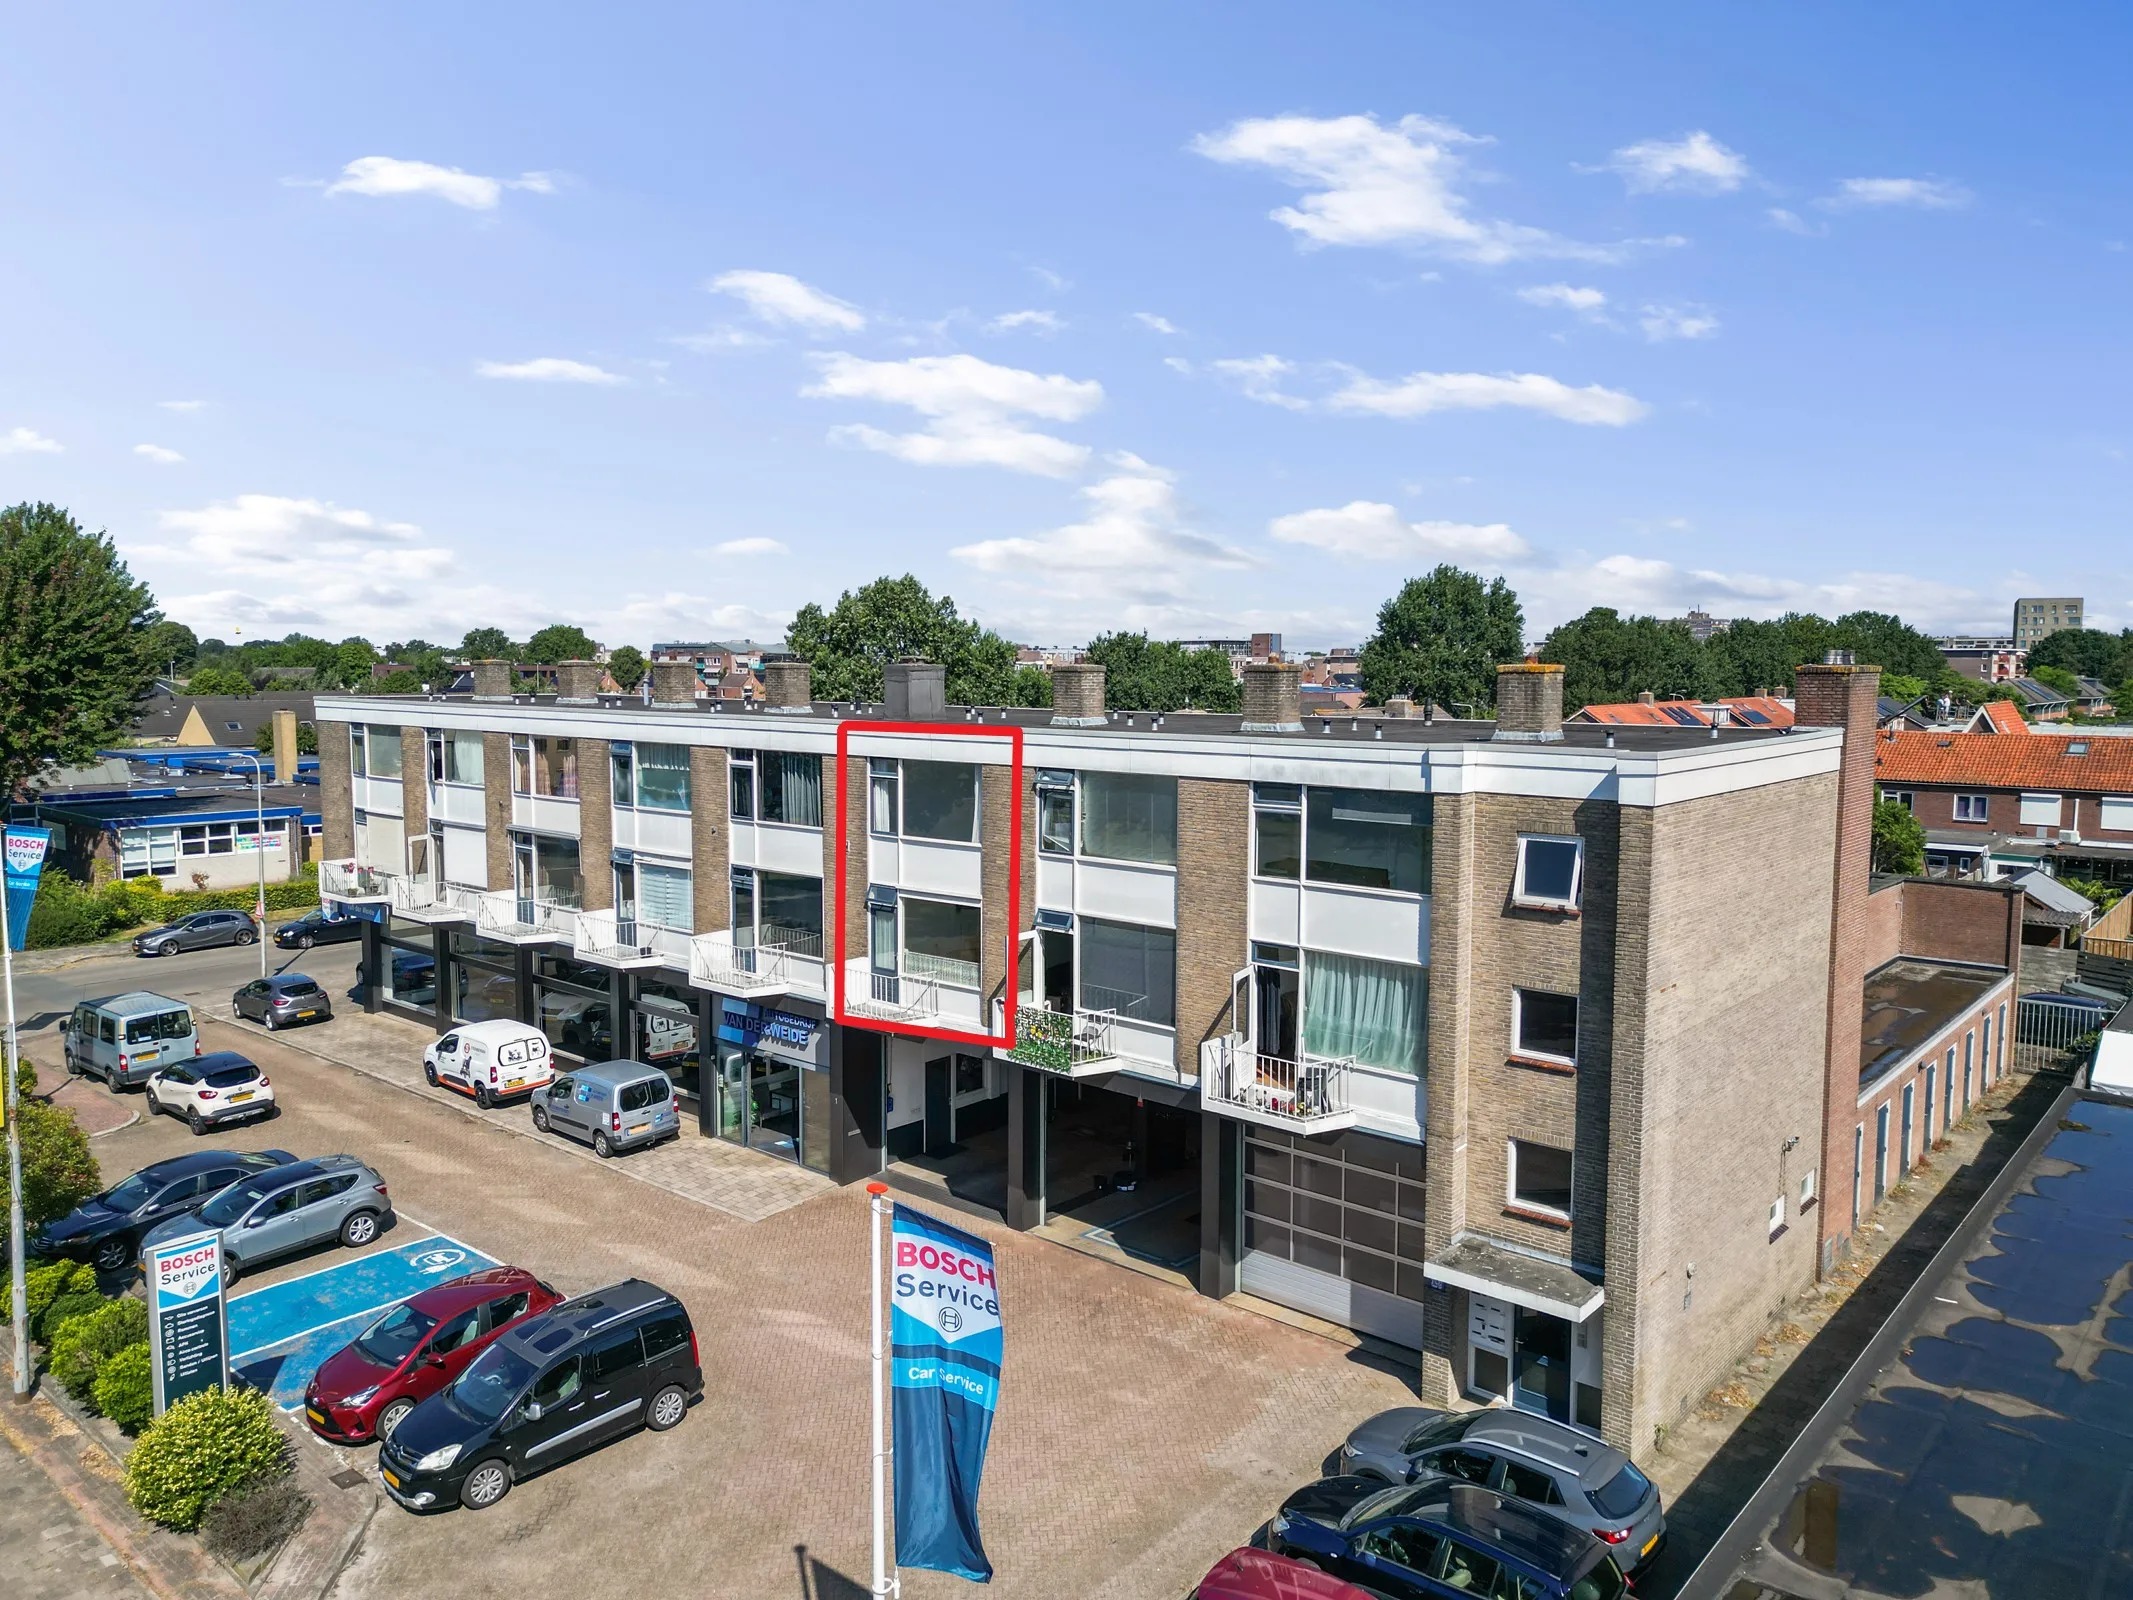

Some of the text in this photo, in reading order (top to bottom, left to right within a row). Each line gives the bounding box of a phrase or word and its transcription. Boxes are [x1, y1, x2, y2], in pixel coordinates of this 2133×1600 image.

[8, 838, 45, 850] BOSCH
[8, 848, 42, 860] Service
[724, 1012, 744, 1029] VAN
[770, 1022, 809, 1045] WEIDE
[160, 1247, 215, 1273] BOSCH
[897, 1241, 996, 1291] BOSCH
[161, 1263, 216, 1285] Service
[896, 1272, 1000, 1317] Service
[908, 1366, 984, 1395] Car Service
